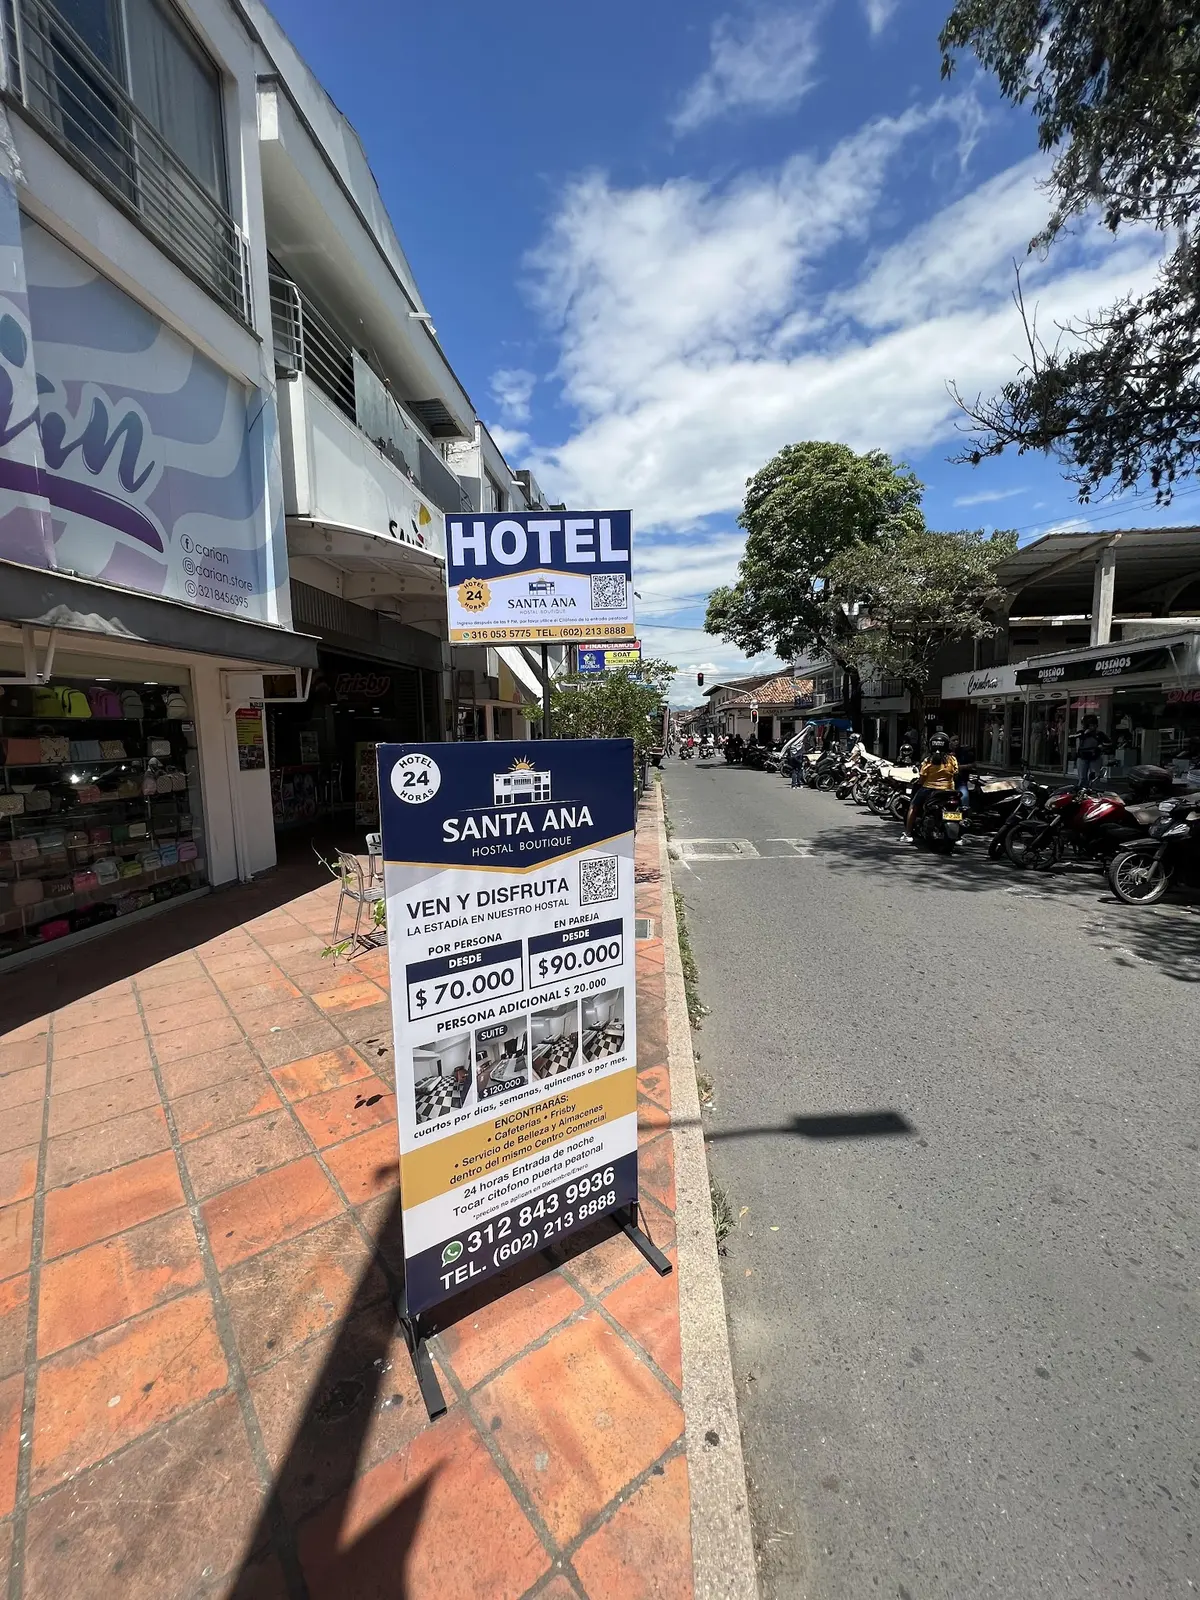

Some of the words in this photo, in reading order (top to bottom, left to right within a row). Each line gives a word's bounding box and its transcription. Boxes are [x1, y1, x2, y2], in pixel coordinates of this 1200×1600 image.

[196, 544, 228, 564] carian
[451, 518, 628, 566] HOTEL
[196, 566, 252, 592] carian.store
[464, 582, 484, 590] HOTEL
[198, 584, 248, 608] 3218456395
[466, 590, 482, 600] 24
[508, 598, 547, 608] SANTA
[551, 598, 576, 608] ANA
[510, 629, 531, 637] 5775
[560, 628, 582, 637] (602)
[335, 672, 390, 698] Frisby
[400, 756, 433, 769] HOTEL
[402, 771, 430, 787] 24
[400, 788, 434, 802] HORAS
[442, 812, 534, 843] SANTA
[542, 805, 594, 832] ANA
[472, 843, 513, 857] HOSTAL
[520, 836, 572, 851] BOUTIQUE
[407, 897, 450, 919] VEN
[456, 894, 470, 910] Y
[476, 878, 569, 908] DISFRUTA
[408, 926, 422, 937] LA
[424, 916, 468, 934] ESTADÍA
[472, 914, 484, 924] EN
[488, 905, 532, 921] NUESTRO
[534, 898, 569, 912] HOSTAL
[554, 919, 566, 929] EN
[569, 912, 600, 926] PAREJA
[428, 943, 450, 956] POR
[454, 932, 502, 950] PERSONA
[562, 929, 590, 942] DESDE
[448, 953, 482, 969] DESDE
[434, 968, 514, 1004] 70.000
[436, 1008, 495, 1033] PERSONA
[498, 990, 561, 1016] ADICIONAL
[573, 978, 606, 994] 20.000
[480, 1026, 505, 1040] SUITE
[414, 1120, 451, 1139] cuartos
[454, 1112, 472, 1127] por
[499, 1088, 541, 1107] semanas,
[543, 1071, 586, 1091] quincenas
[595, 1062, 608, 1074] por
[610, 1057, 628, 1066] mes.
[489, 1078, 521, 1095] 120.000
[494, 1095, 569, 1129] ENCONTRARÁS:
[494, 1117, 541, 1141] Cafeterías
[550, 1103, 576, 1119] Frisby
[450, 1168, 482, 1185] dentro
[485, 1157, 499, 1170] del
[502, 1146, 533, 1162] mismo
[535, 1131, 564, 1148] Centro
[566, 1112, 607, 1134] Comercial
[462, 1146, 500, 1167] Servicio
[503, 1141, 515, 1150] de
[518, 1127, 549, 1145] Belleza
[551, 1124, 556, 1132] y
[559, 1104, 603, 1127] Almacenes
[453, 1202, 485, 1217] Tocar
[488, 1178, 530, 1201] citofono
[532, 1162, 563, 1186] puerta
[565, 1142, 604, 1168] peatonal
[464, 1188, 477, 1199] 24
[480, 1173, 509, 1192] horas
[512, 1155, 550, 1176] Entrada
[553, 1148, 564, 1159] de
[567, 1134, 594, 1152] noche
[510, 1190, 533, 1203] aplican
[542, 1163, 588, 1187] Diciembre/Enero
[467, 1216, 512, 1253] 312
[519, 1193, 559, 1227] 843
[566, 1167, 615, 1205] 9936
[440, 1260, 487, 1290] TEL.
[493, 1230, 538, 1267] (602)
[544, 1212, 574, 1239] 213
[578, 1191, 616, 1219] 8888
